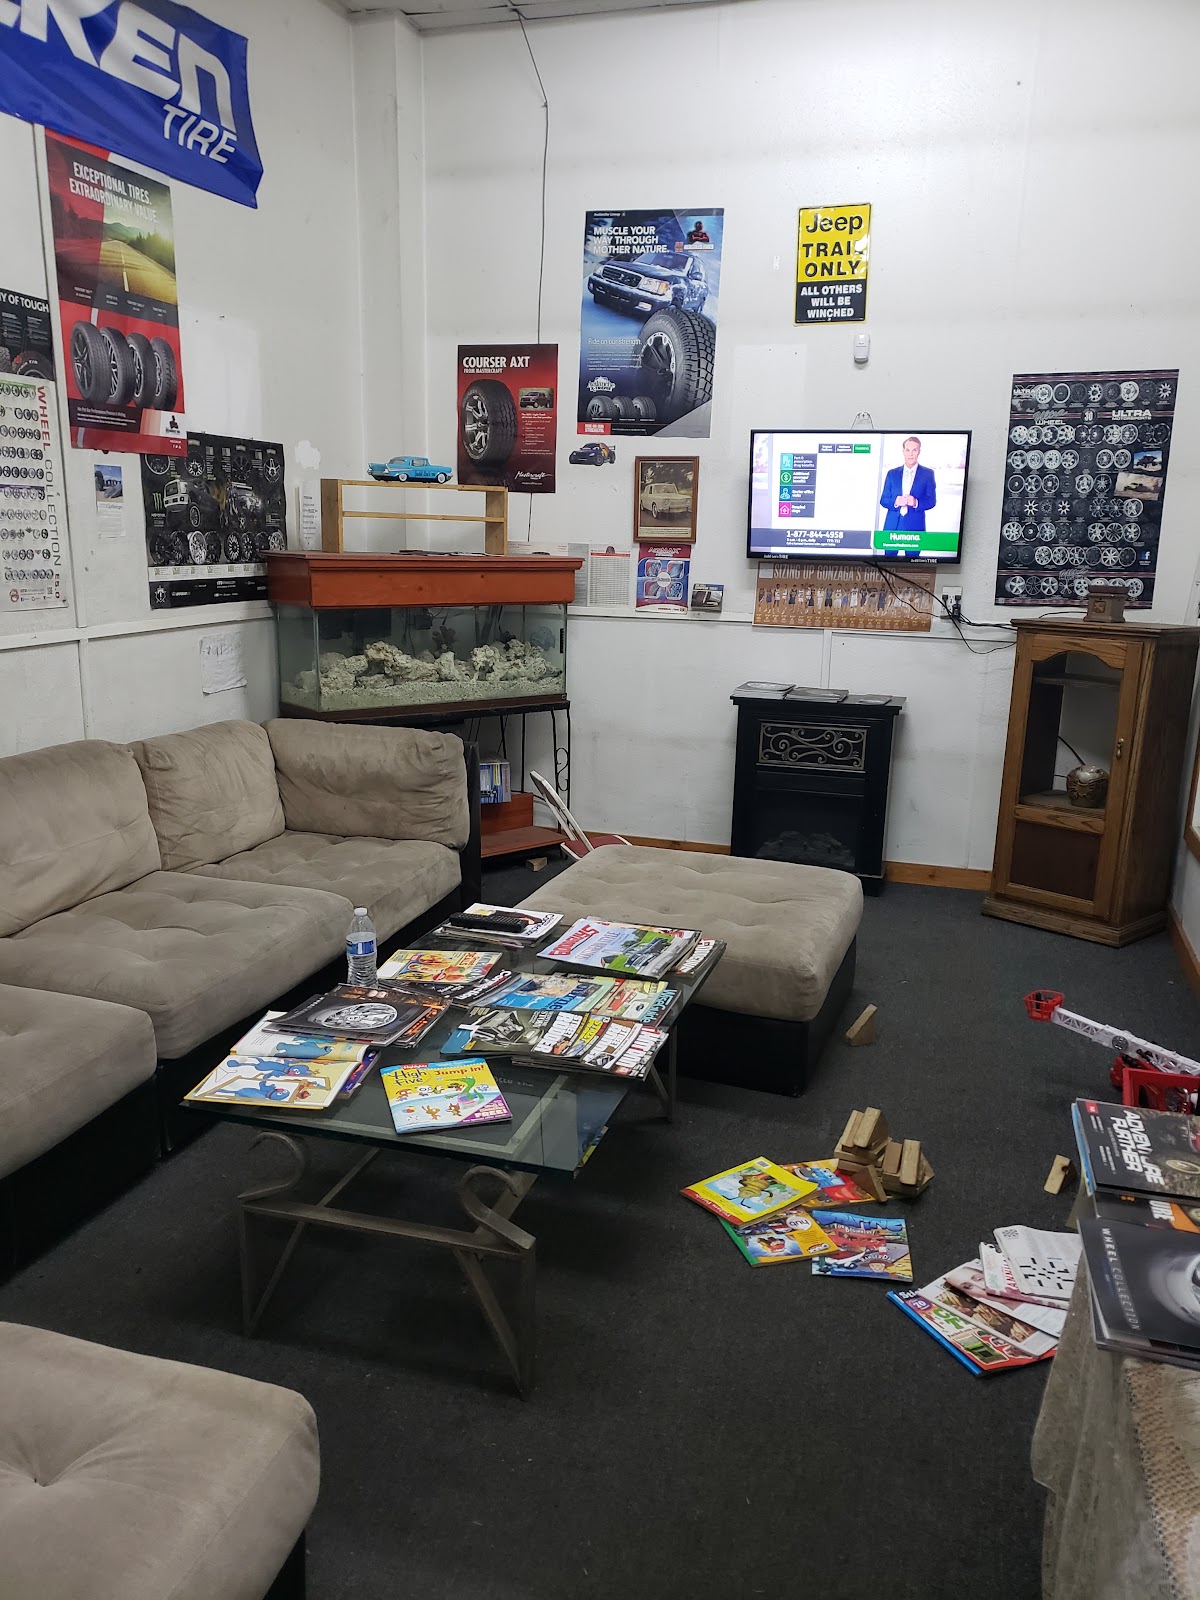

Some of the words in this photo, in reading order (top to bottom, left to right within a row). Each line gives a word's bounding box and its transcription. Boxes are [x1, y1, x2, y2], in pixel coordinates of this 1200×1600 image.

[0, 0, 236, 133] KEN
[162, 104, 238, 163] TIRE
[72, 161, 128, 197] EXCEPTIONAL
[127, 184, 153, 206] TIRES.
[68, 177, 135, 214] EXTRAORDINARY
[135, 203, 161, 225] VALUE.
[593, 226, 630, 236] MUSCLE
[631, 225, 656, 235] YOUR
[805, 213, 863, 234] Jeep
[593, 236, 614, 245] WAY
[614, 235, 659, 245] THROUGH
[593, 245, 632, 255] MOTHER
[632, 244, 670, 254] NATURE.
[804, 260, 861, 278] ONLY
[800, 286, 820, 296] ALL
[821, 284, 863, 295] OTHERS
[8, 294, 19, 306] OF
[20, 297, 49, 313] TOUGH
[811, 297, 835, 307] WILL
[837, 296, 851, 306] BE
[807, 307, 854, 319] WINCHED
[618, 337, 642, 347] strength.
[463, 356, 507, 368] COURSER
[509, 356, 530, 368] AXT
[37, 386, 51, 451] WHEEL
[45, 459, 61, 566] COLLECTION
[786, 530, 844, 539] 1-877-844-4958
[773, 563, 801, 580] SIZING
[803, 565, 815, 580] UP
[817, 565, 862, 582] GONZAGA'S
[532, 1011, 572, 1054] RODDER
[563, 1014, 583, 1039] STREET
[390, 1069, 427, 1080] High
[434, 1067, 468, 1076] Jump
[394, 1077, 424, 1086] Five
[1109, 1115, 1141, 1174] FURTHER
[789, 1218, 809, 1229] hub
[1100, 1226, 1116, 1265] WHEEL
[1112, 1264, 1142, 1331] COLLECTION
[912, 1300, 927, 1308] 70
